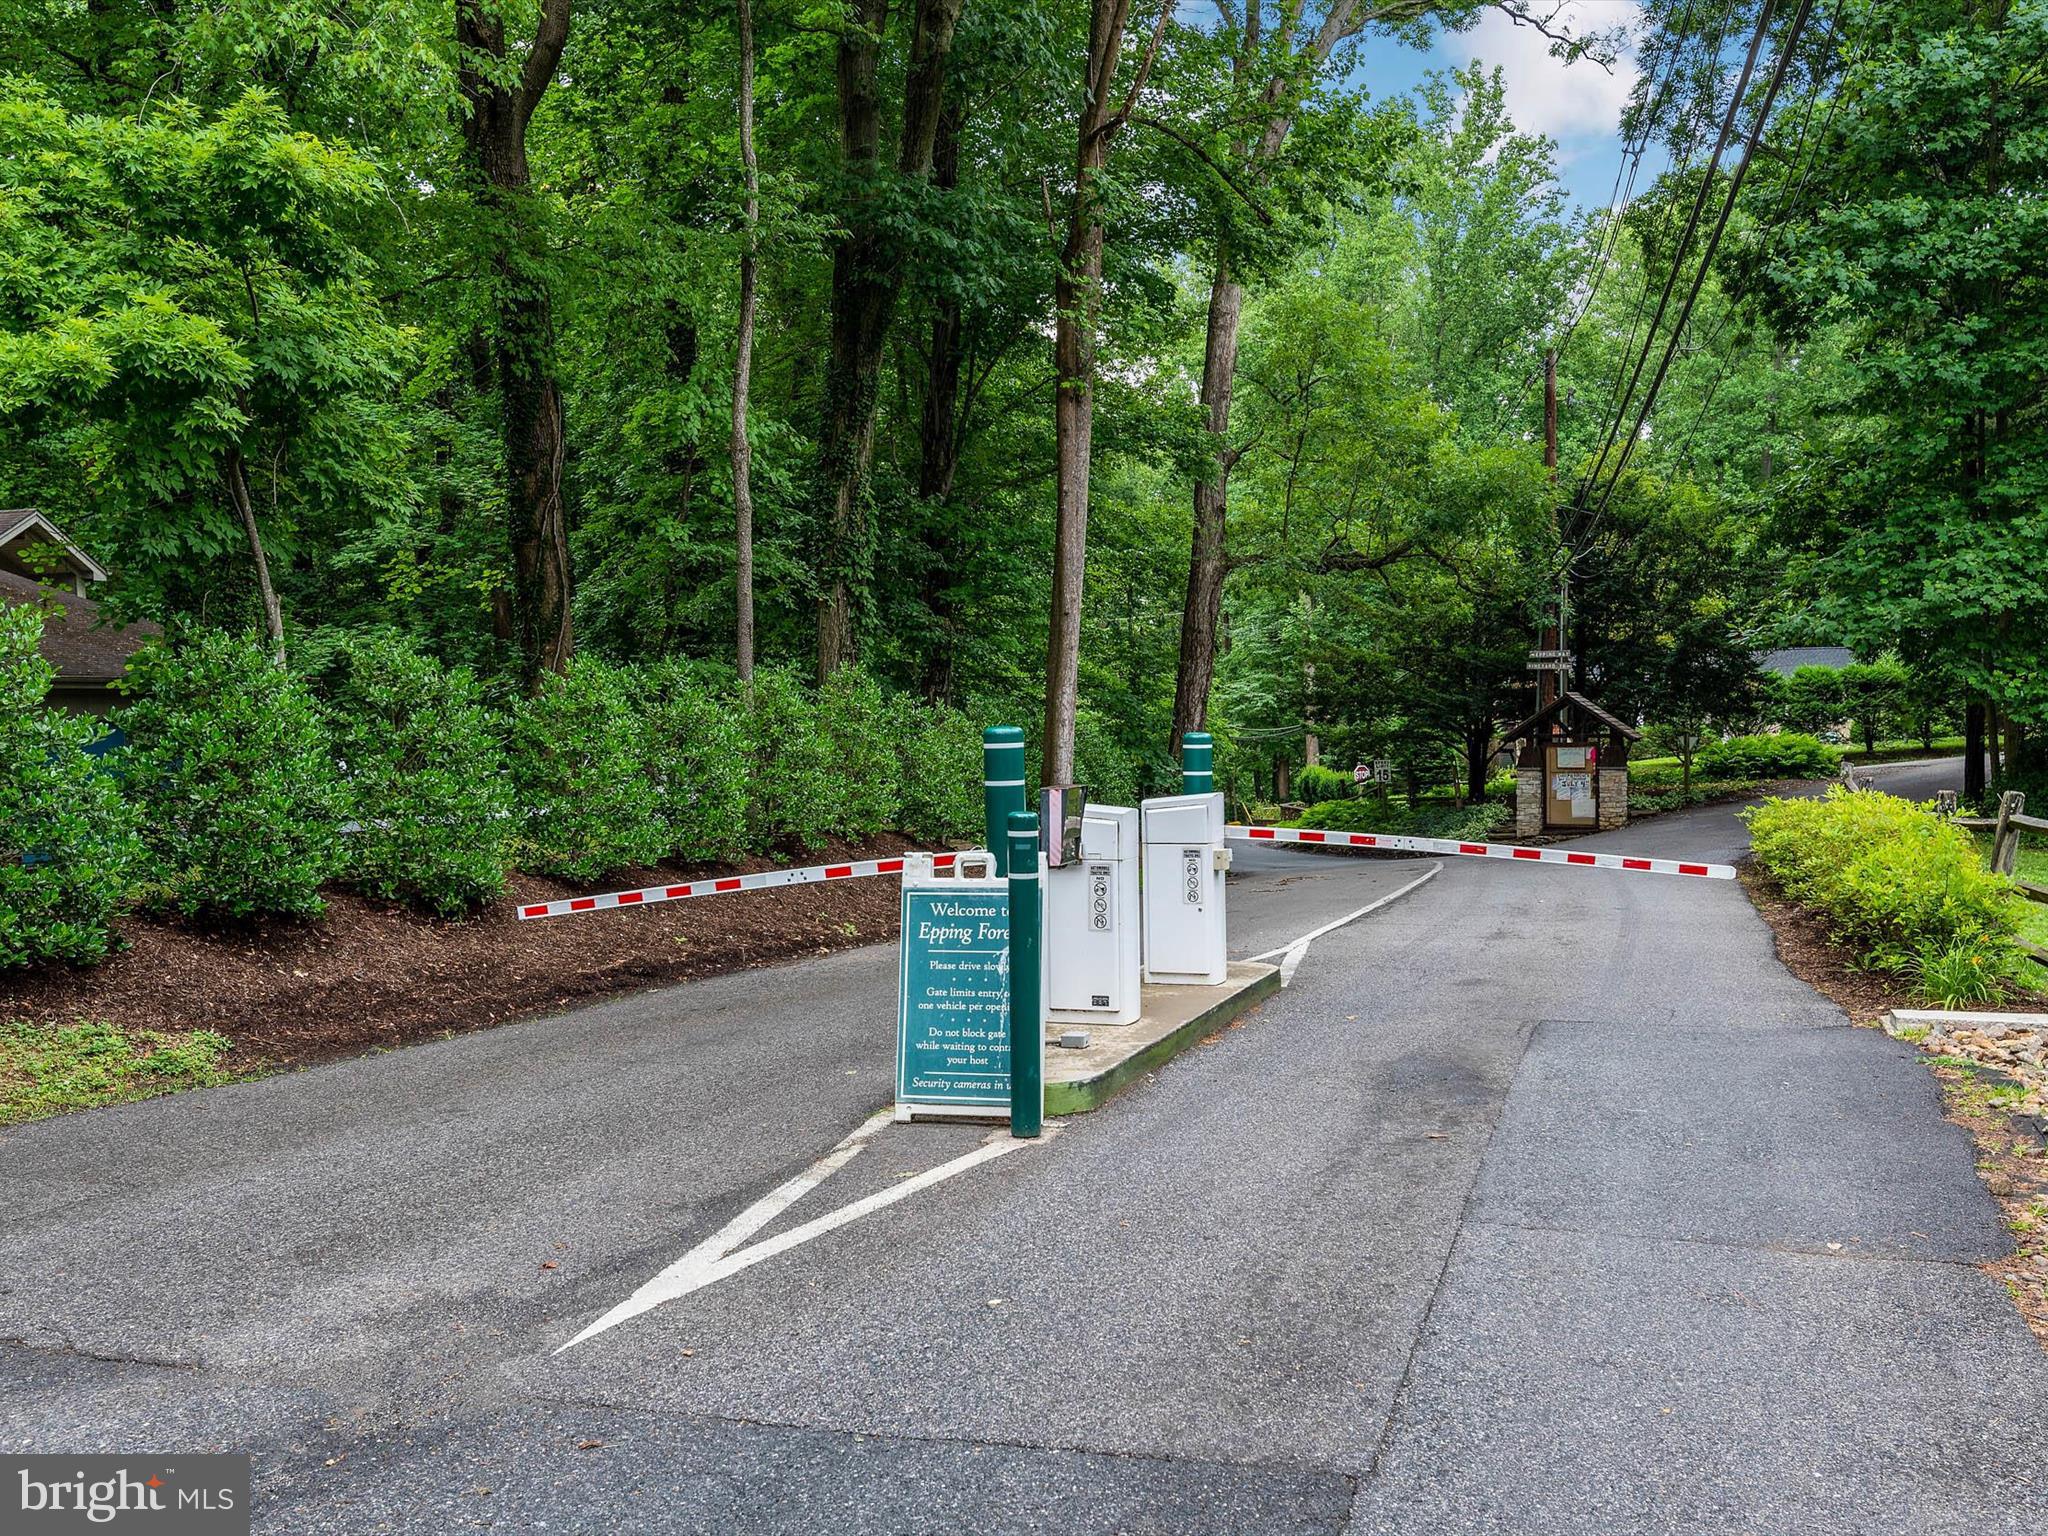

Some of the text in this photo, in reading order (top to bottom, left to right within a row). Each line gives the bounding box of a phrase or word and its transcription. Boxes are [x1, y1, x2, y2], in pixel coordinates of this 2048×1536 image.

[1355, 771, 1369, 779] STOP
[1377, 769, 1389, 781] 15
[930, 902, 997, 917] Welcome
[918, 921, 1010, 945] Epping Fore
[929, 960, 956, 970] Please
[958, 961, 982, 970] drive
[926, 987, 948, 997] Gate
[950, 988, 976, 997] limits
[978, 990, 1001, 1000] entry
[936, 1001, 967, 1010] vehicle
[969, 1004, 983, 1012] per
[928, 1027, 1007, 1040] Do not block gate
[916, 1040, 940, 1050] while
[942, 1042, 976, 1053] waiting
[946, 1055, 988, 1066] your host
[912, 1076, 951, 1091] Security
[953, 1081, 992, 1090] cameras
[994, 1080, 1004, 1090] in
